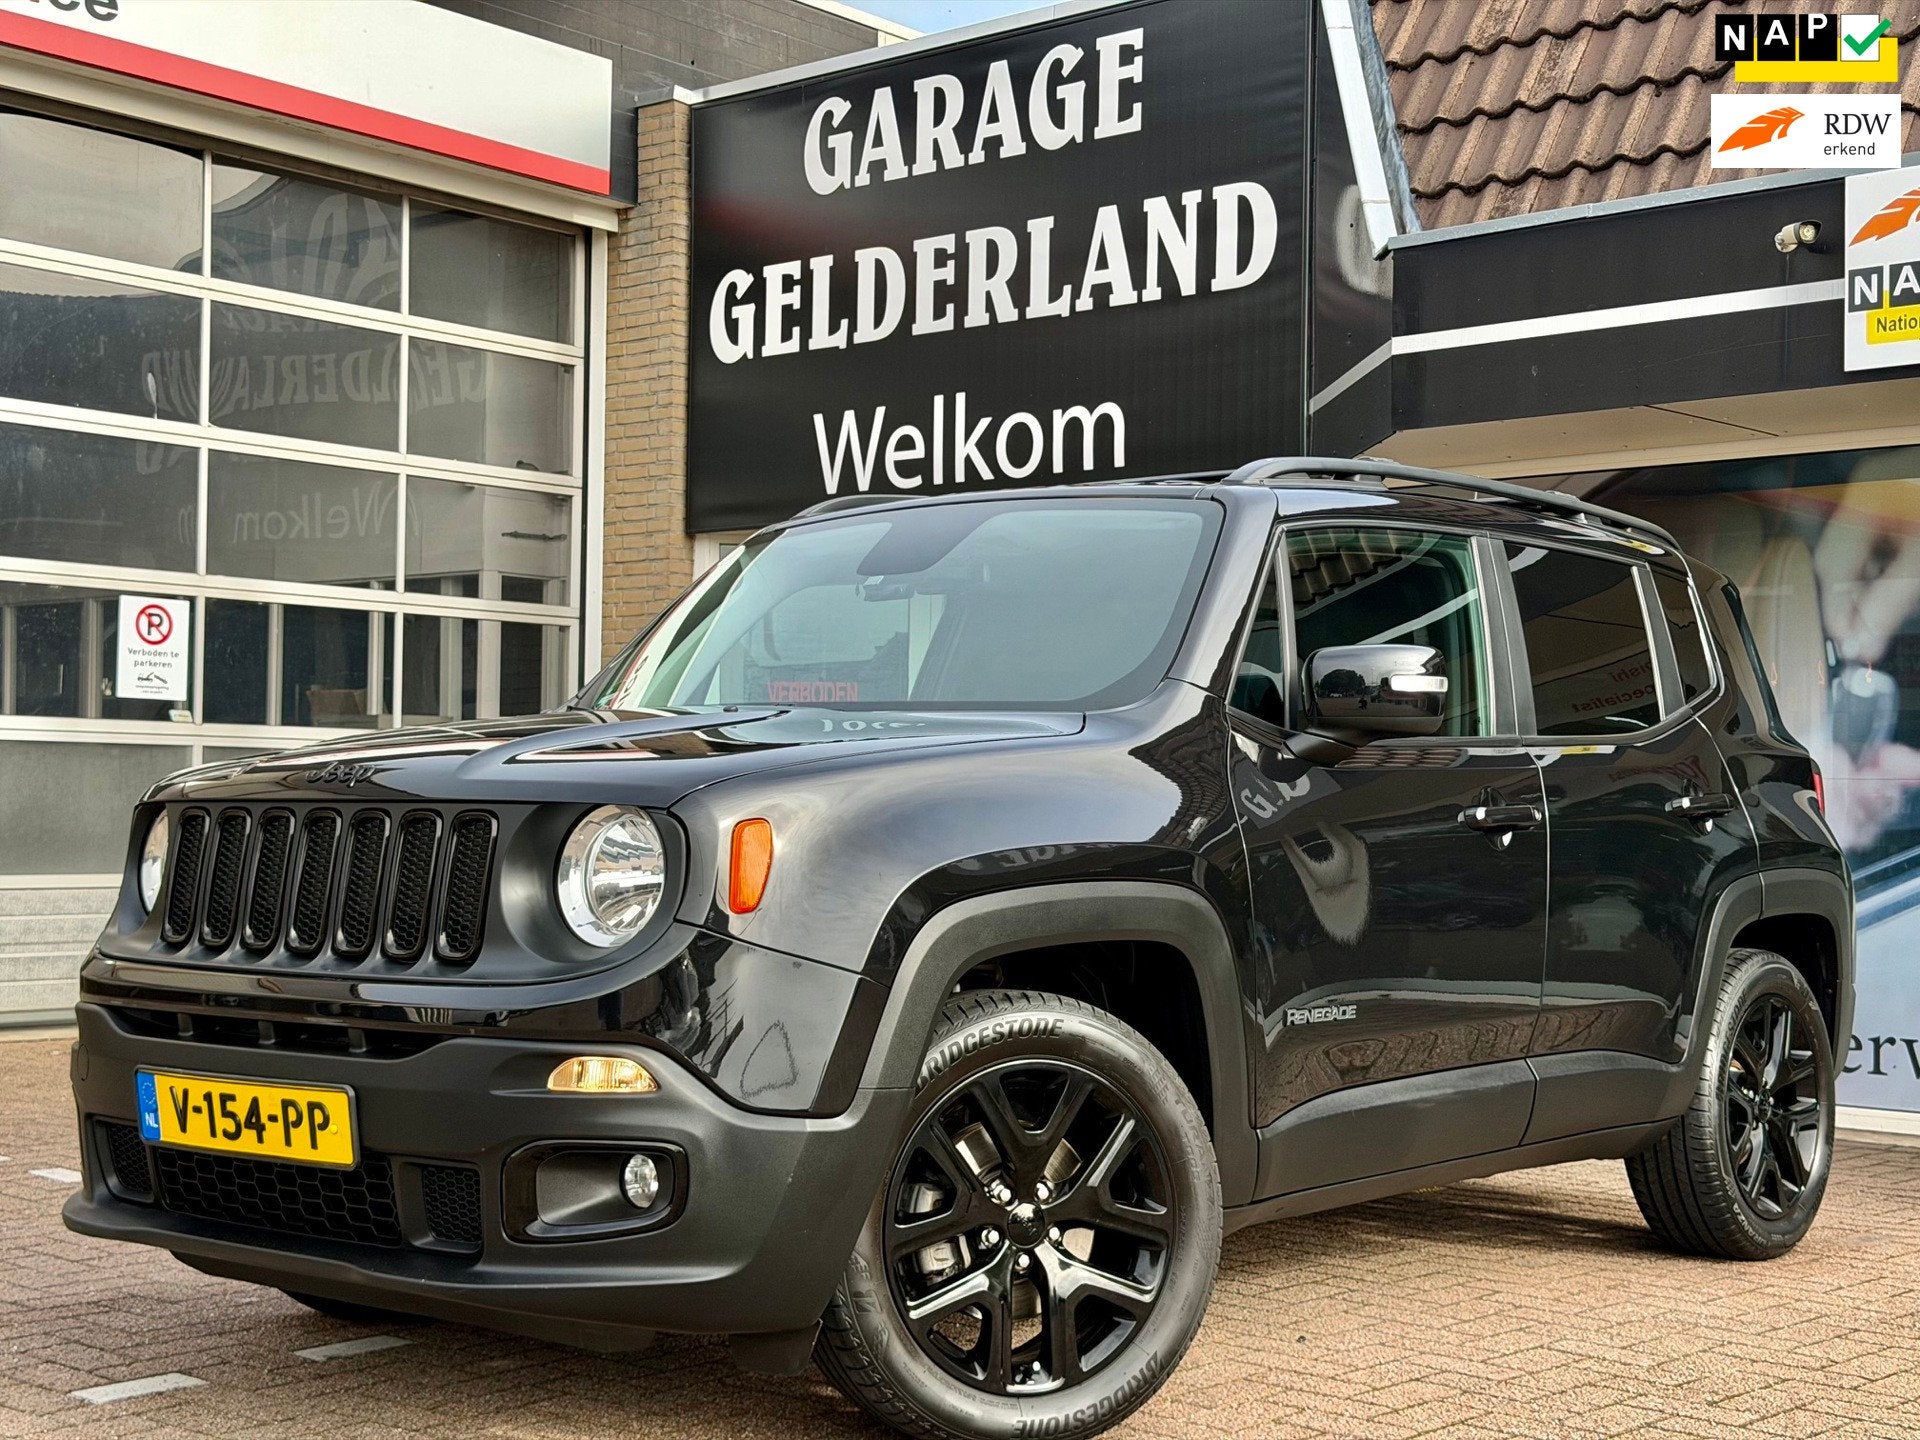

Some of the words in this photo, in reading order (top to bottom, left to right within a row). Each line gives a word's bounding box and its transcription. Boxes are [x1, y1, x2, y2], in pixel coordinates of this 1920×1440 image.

[804, 27, 1145, 195] GARAGE
[709, 181, 1278, 364] GELDERLAND
[1876, 314, 1920, 333] Natio
[813, 392, 1125, 495] Welkom
[127, 647, 168, 658] Verboden
[170, 650, 180, 658] te
[133, 659, 173, 669] parkeren
[306, 761, 376, 788] Jeep
[1286, 1004, 1357, 1026] RENEGADE
[145, 1111, 159, 1128] NL
[169, 1086, 331, 1150] V-154-PP
[1014, 1350, 1166, 1439] BRIDGESTONE
